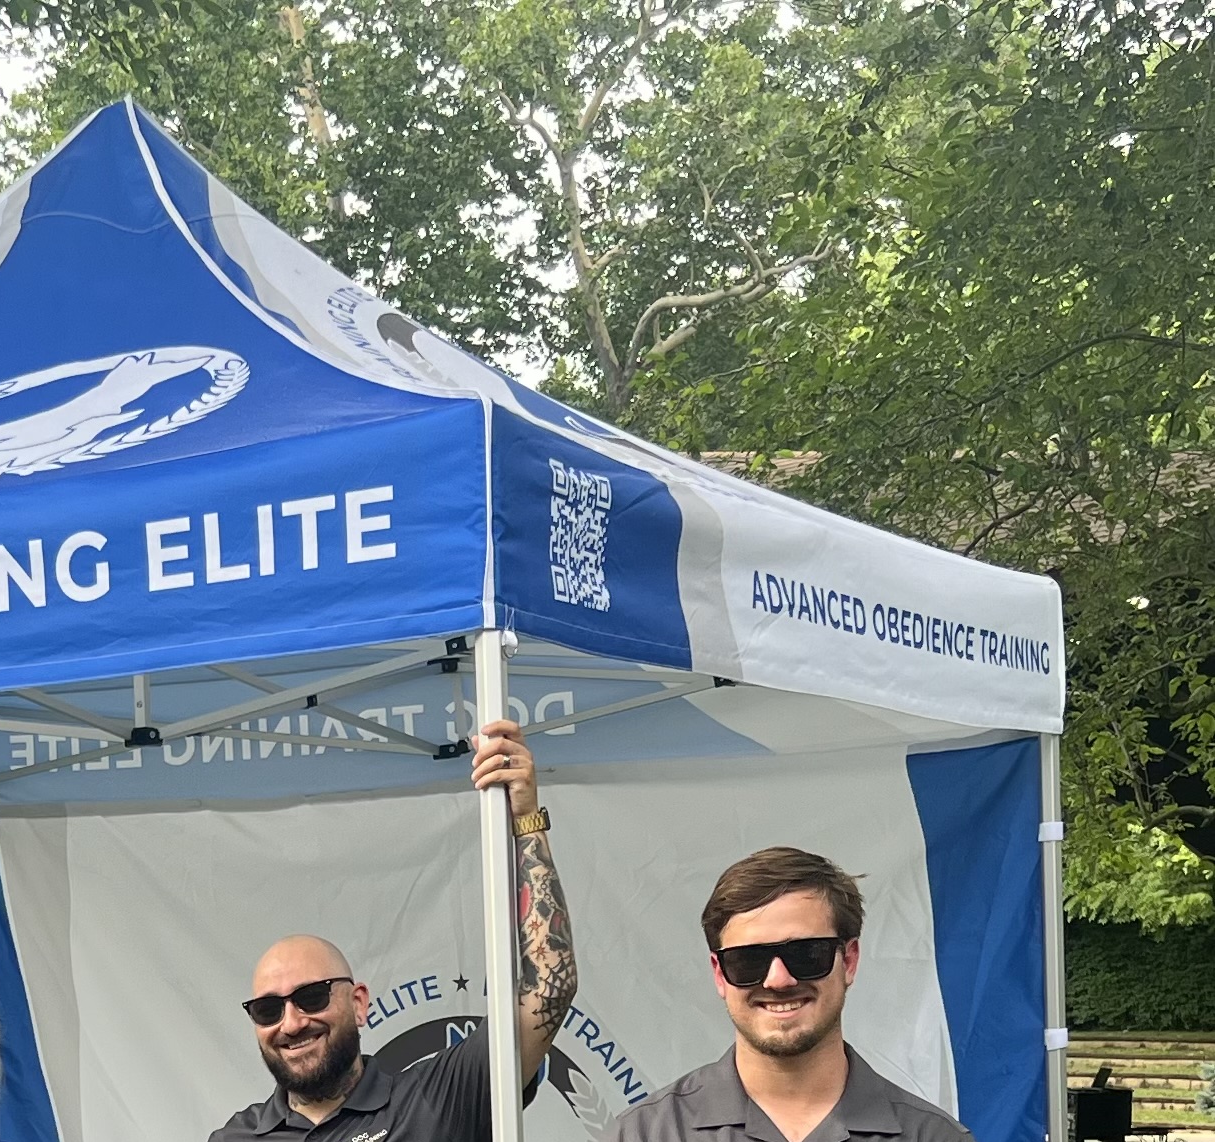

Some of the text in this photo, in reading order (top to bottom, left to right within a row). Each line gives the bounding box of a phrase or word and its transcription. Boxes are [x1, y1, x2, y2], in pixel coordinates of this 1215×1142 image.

[146, 484, 398, 592] ELITE
[752, 569, 1050, 675] ADVANCED OBEDIENCE TRAINING
